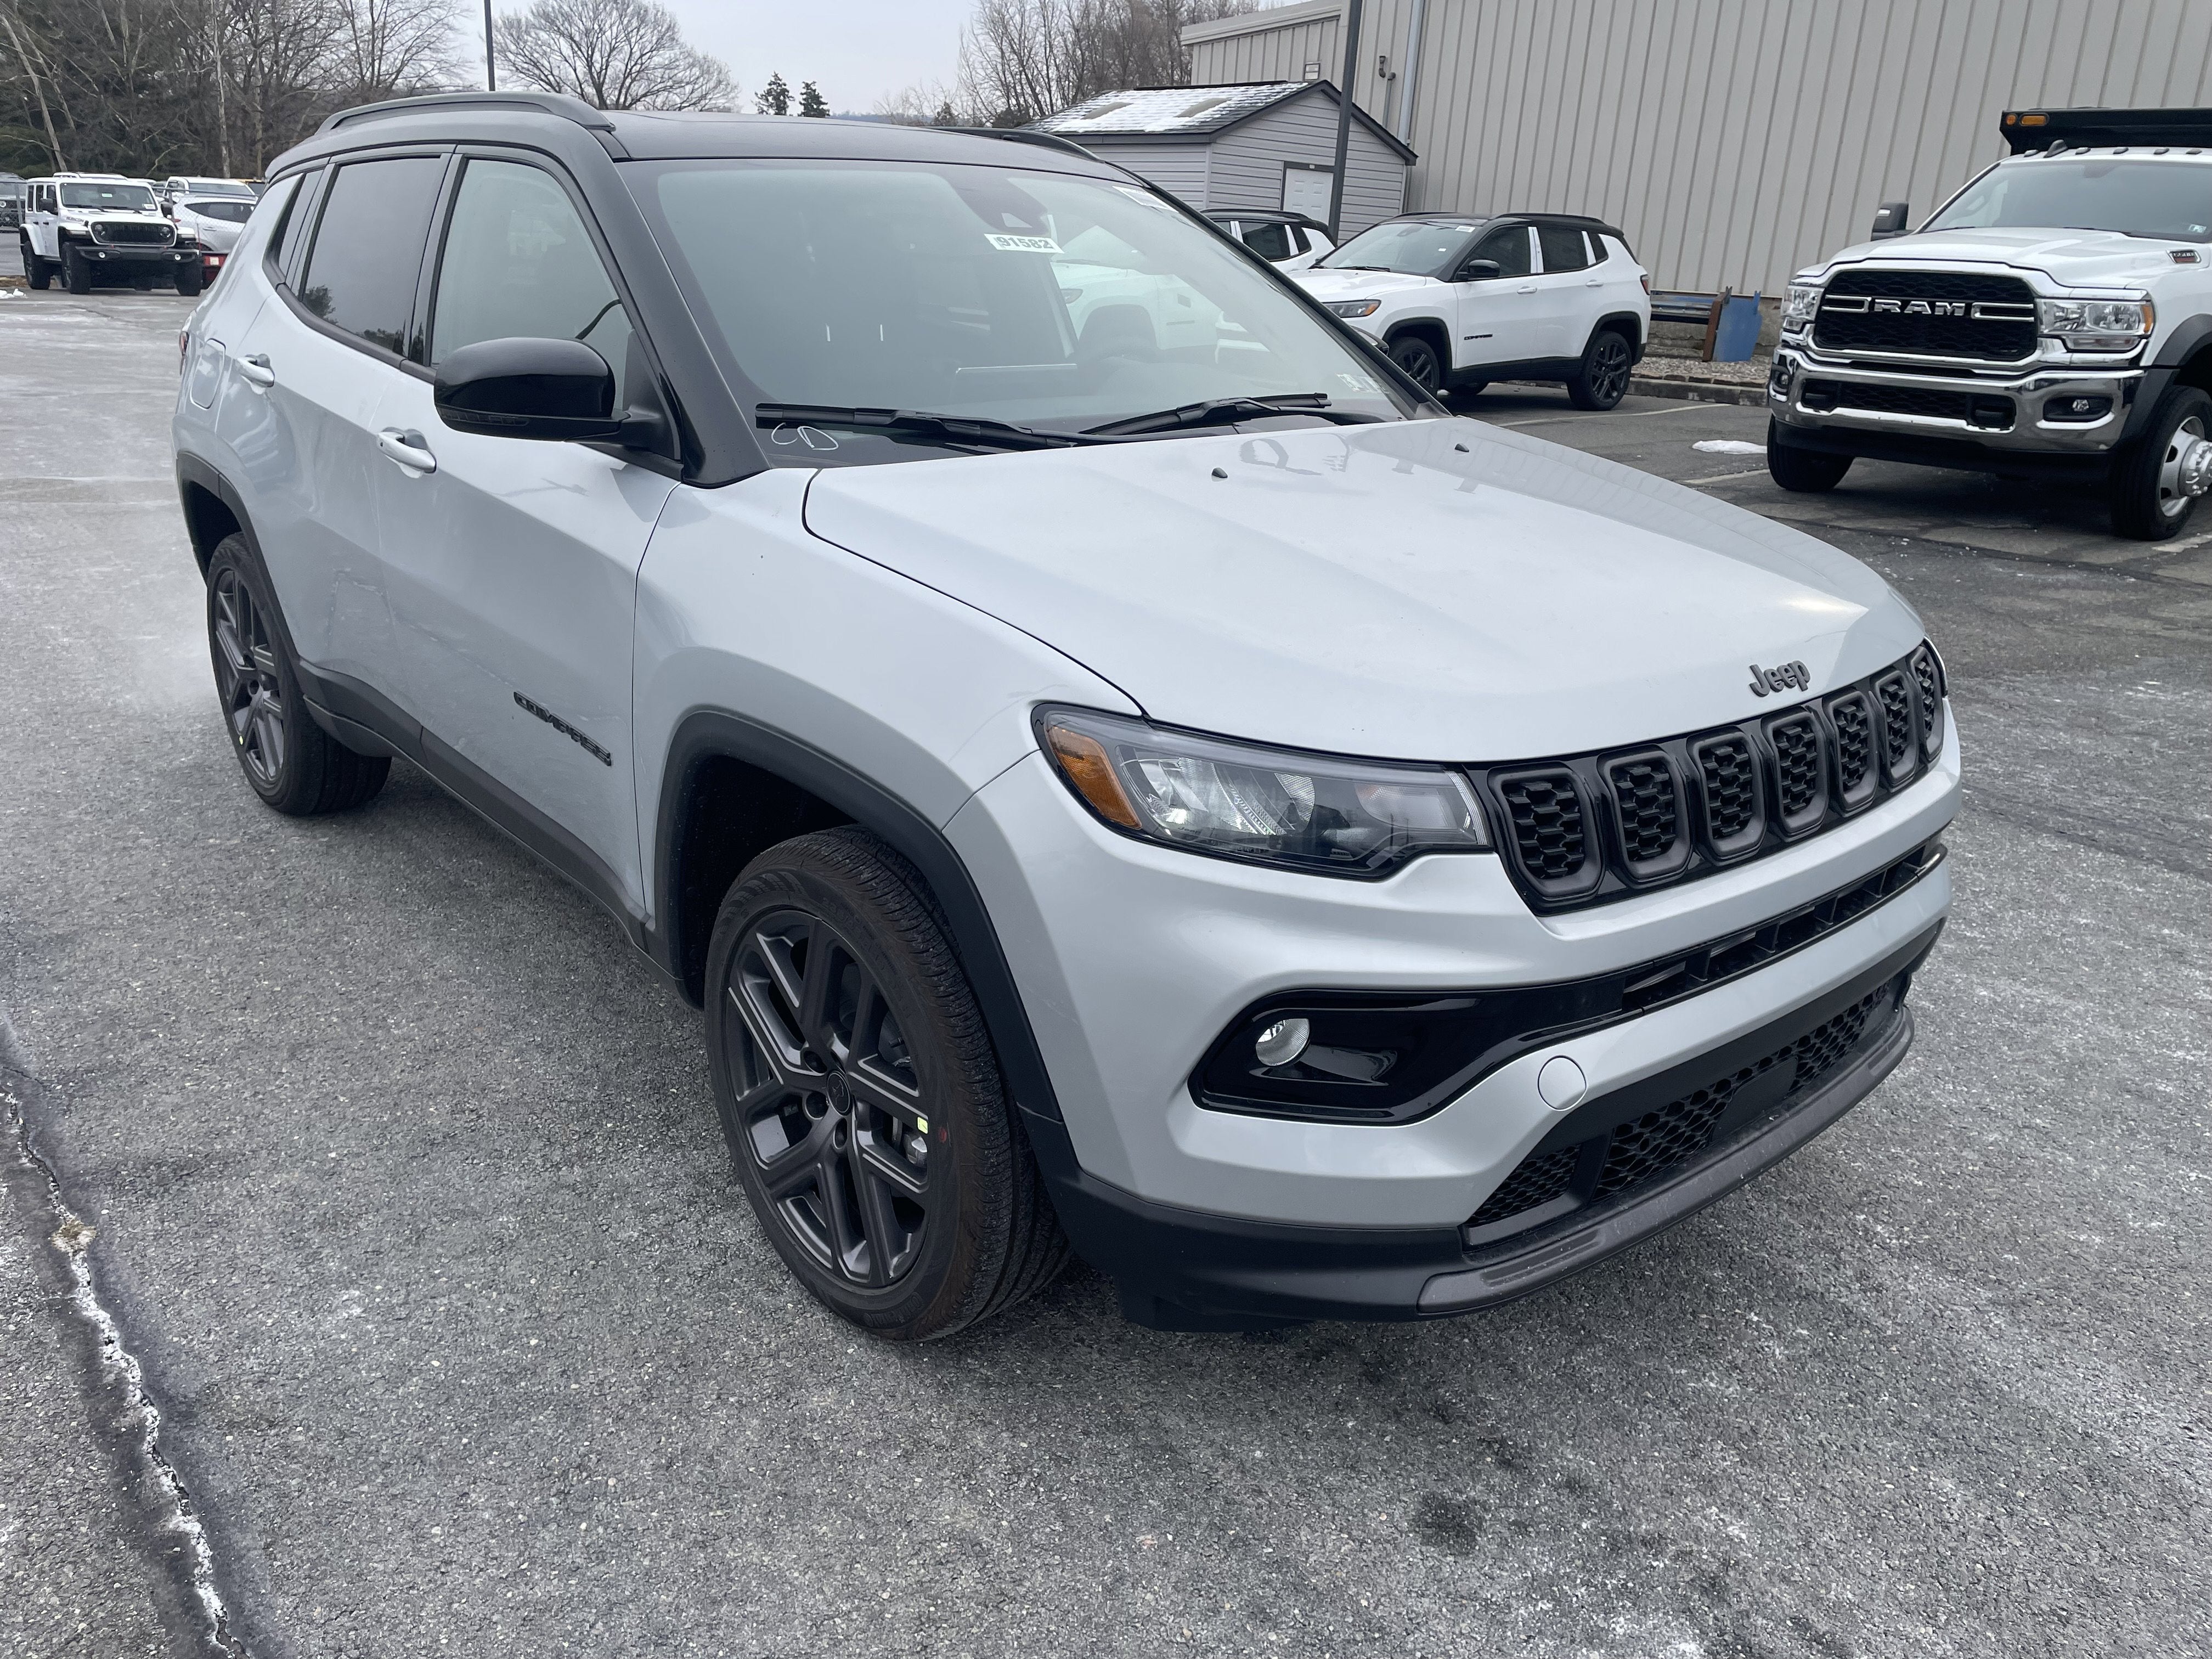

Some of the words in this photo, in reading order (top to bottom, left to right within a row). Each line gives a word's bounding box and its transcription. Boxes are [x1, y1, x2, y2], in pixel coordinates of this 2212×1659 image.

[996, 236, 1054, 249] 91582
[1874, 299, 1966, 316] RAM
[1749, 660, 1811, 697] Jeep
